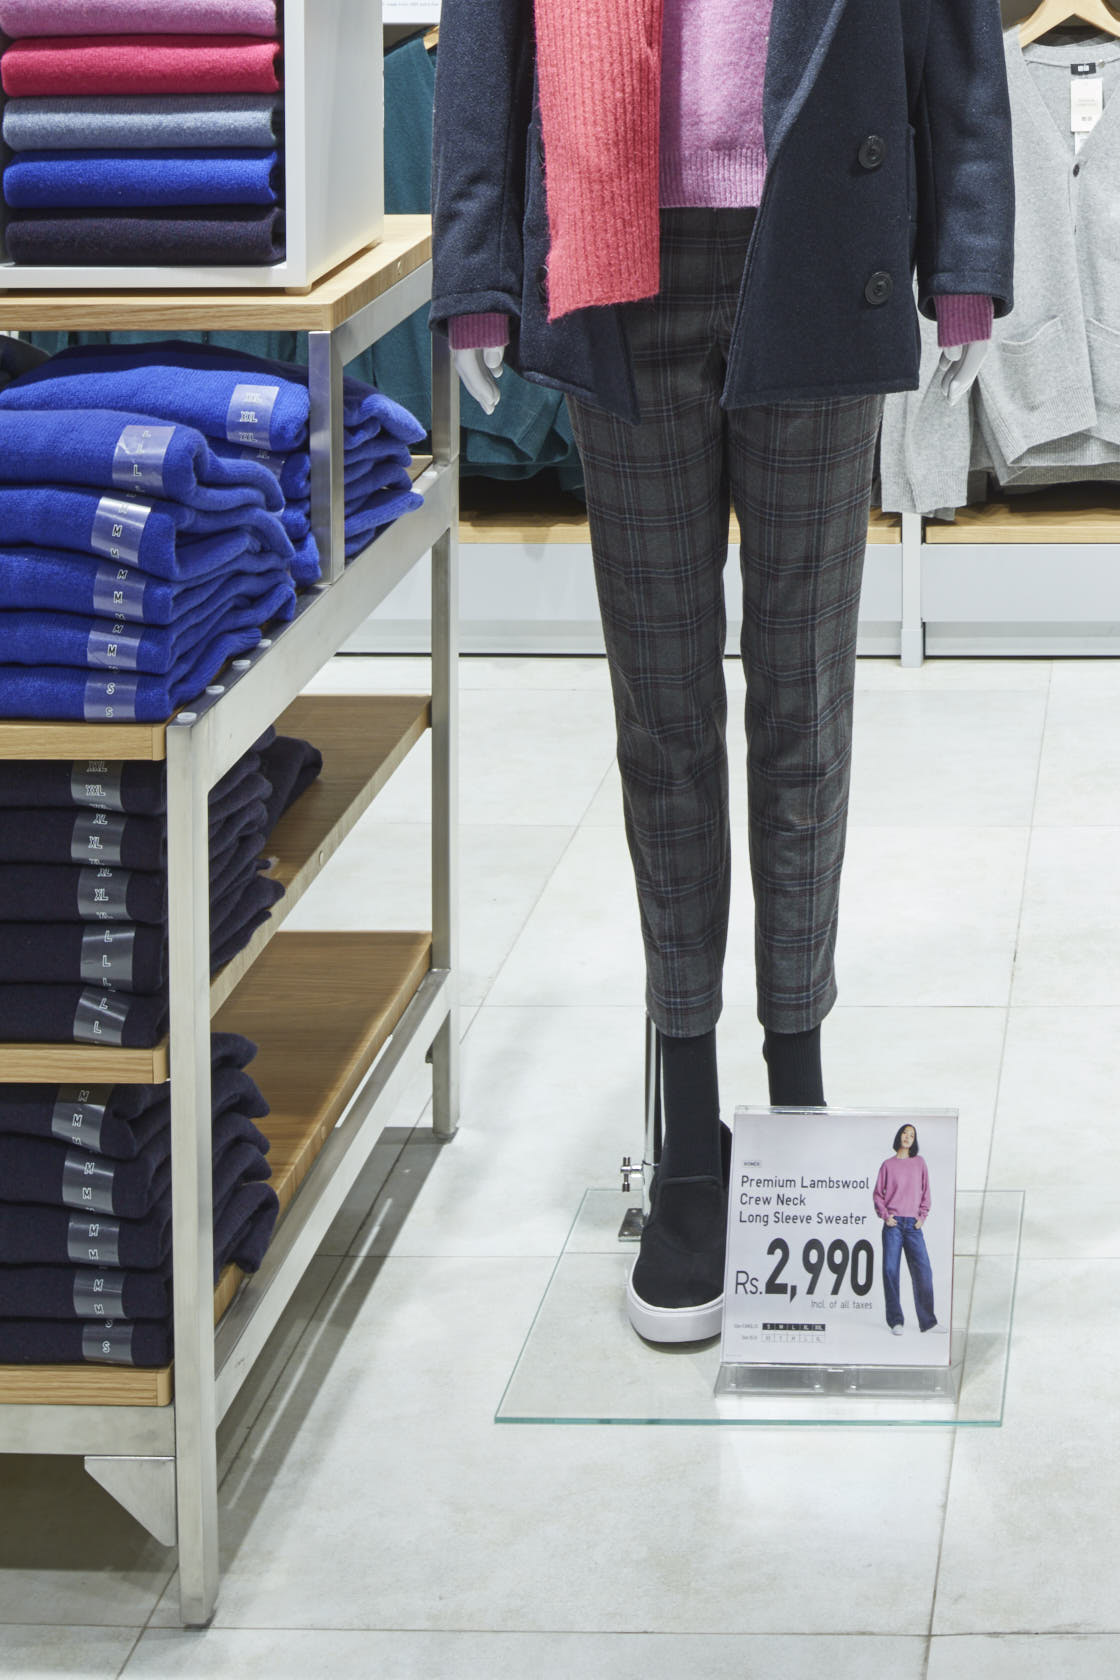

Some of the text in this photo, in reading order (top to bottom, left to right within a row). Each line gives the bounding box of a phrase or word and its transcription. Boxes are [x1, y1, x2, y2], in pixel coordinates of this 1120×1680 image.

[133, 464, 142, 477] L
[112, 524, 122, 538] M
[113, 591, 123, 604] M
[107, 644, 117, 657] M
[106, 682, 116, 695] S
[105, 706, 114, 718] S
[85, 784, 106, 797] XXL
[88, 835, 103, 850] XL
[94, 888, 109, 902] XL
[104, 929, 113, 943] L
[102, 954, 111, 968] L
[99, 997, 108, 1010] L
[93, 1020, 102, 1034] L
[72, 1113, 83, 1127] M
[83, 1162, 95, 1174] M
[741, 1175, 870, 1190] Premium Lambswool
[82, 1187, 92, 1200] M
[739, 1193, 806, 1207] Crew Neck
[739, 1211, 867, 1227] Long Sleeve Sweater
[88, 1223, 99, 1237] M
[93, 1278, 104, 1292] M
[102, 1340, 111, 1354] S
